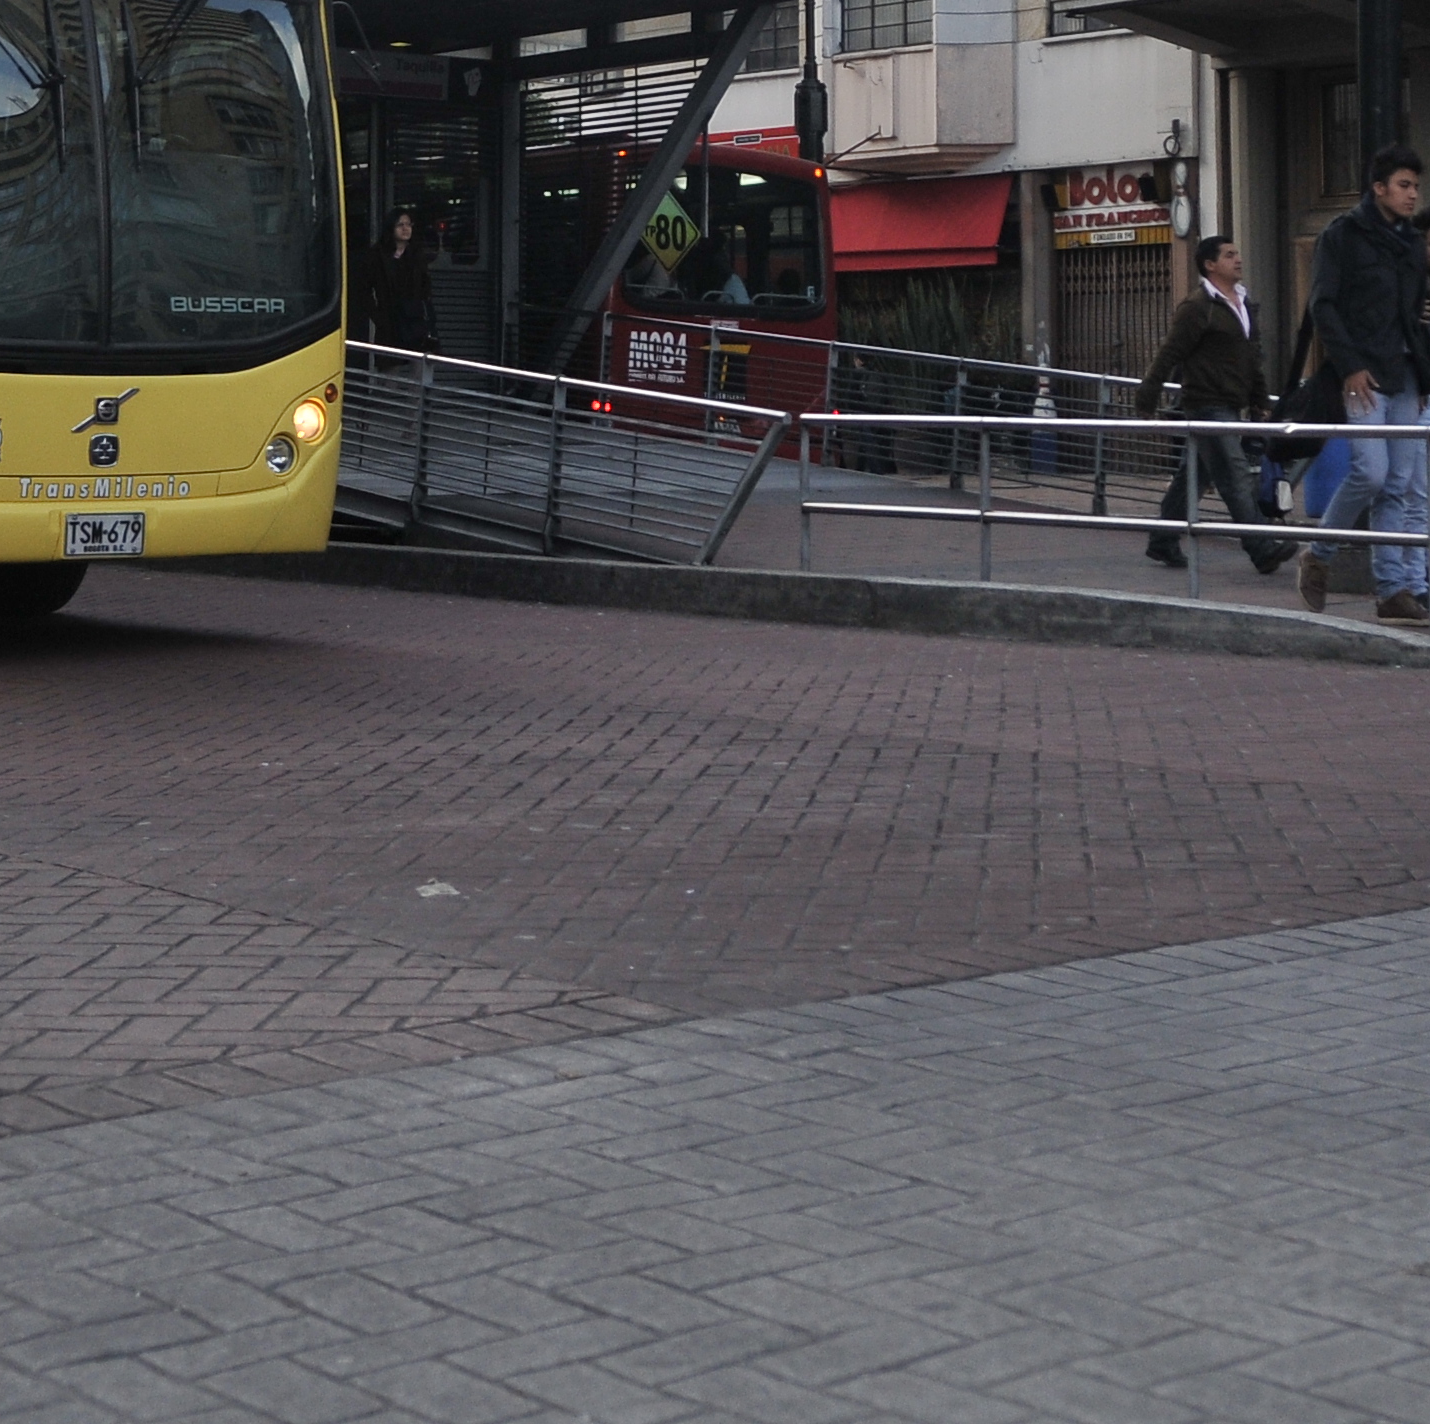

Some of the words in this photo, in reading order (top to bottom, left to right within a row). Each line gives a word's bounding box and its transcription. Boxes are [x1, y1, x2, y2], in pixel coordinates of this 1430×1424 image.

[395, 57, 445, 75] Taquilla
[655, 213, 687, 252] 80
[170, 295, 286, 315] BUSSCAR
[18, 476, 191, 499] TransMilenio
